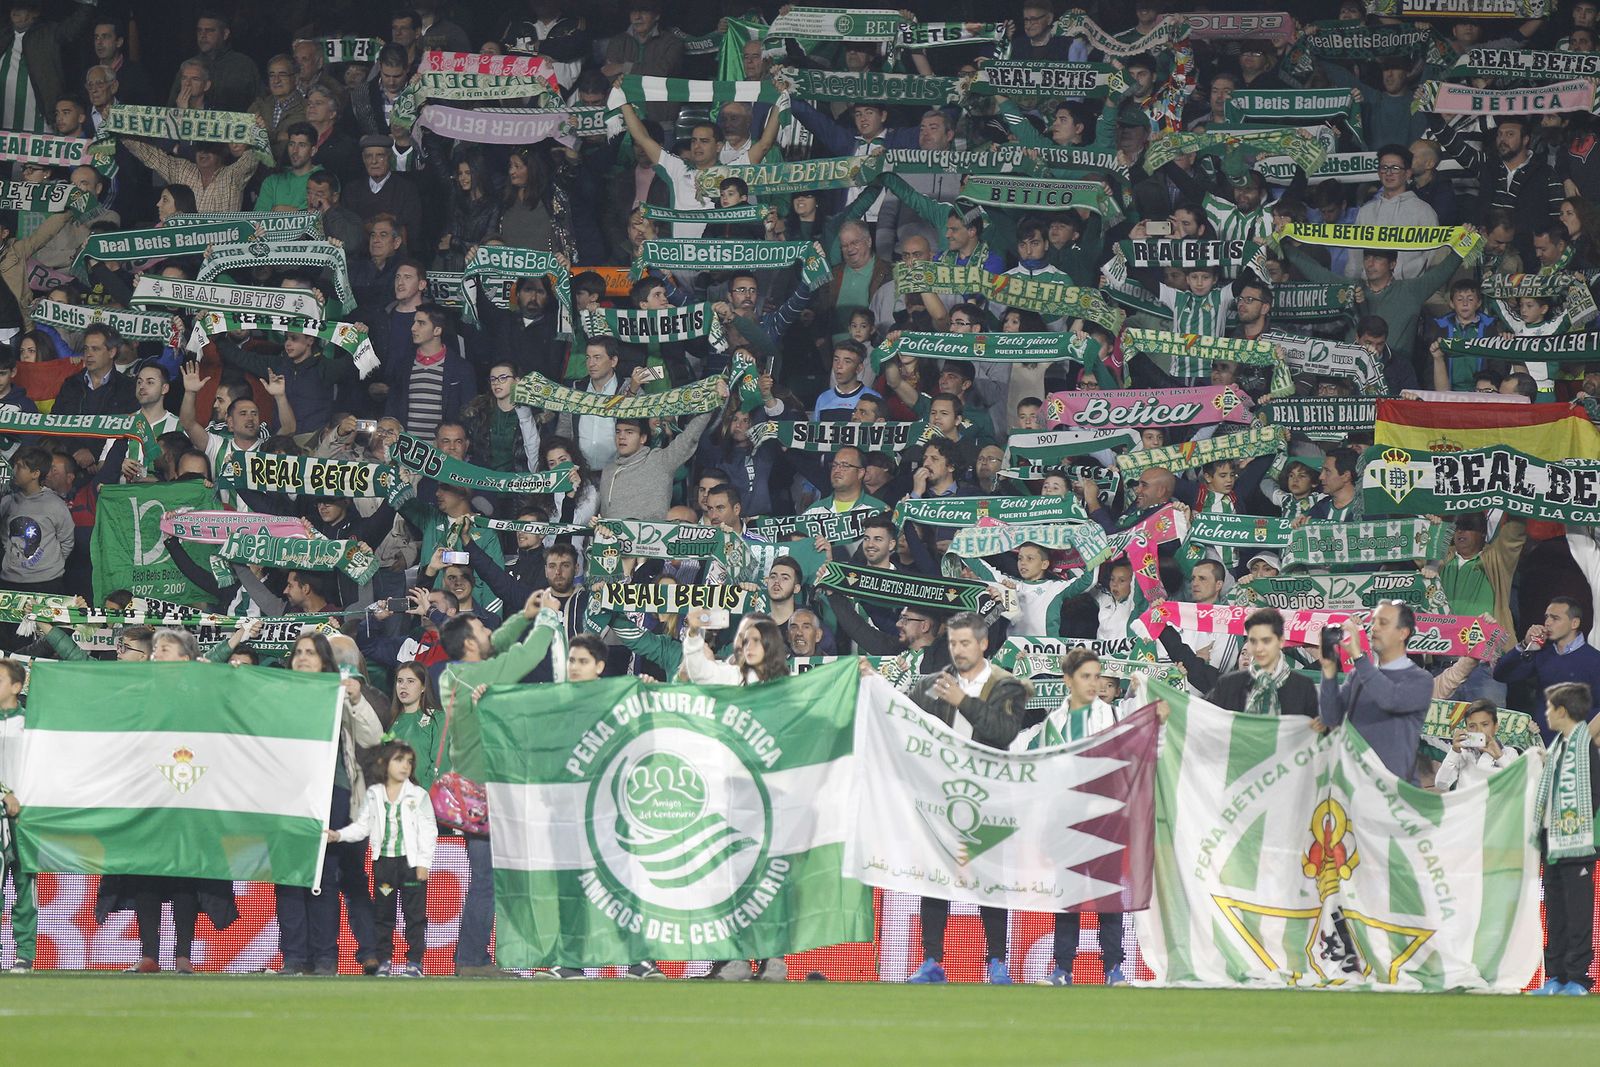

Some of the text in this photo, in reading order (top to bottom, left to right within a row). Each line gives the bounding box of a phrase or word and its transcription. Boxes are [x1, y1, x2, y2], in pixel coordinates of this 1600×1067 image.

[1188, 16, 1284, 33] BÉTIC
[1467, 49, 1598, 74] REAL BETIS
[988, 68, 1098, 89] REAL BETIS
[1254, 96, 1290, 110] Betis
[1471, 95, 1562, 111] BETICA
[30, 138, 83, 160] BETIS
[790, 160, 849, 183] BETIS
[991, 188, 1073, 205] BETICO
[1293, 224, 1455, 244] REAL BETIS BALOMPIÉ
[99, 240, 130, 254] Real
[134, 236, 171, 250] Betis
[937, 265, 994, 288] REAL
[1008, 278, 1081, 304] BETIS
[230, 290, 286, 309] BETIS
[1279, 287, 1329, 308] BALOMPIÉ
[52, 304, 85, 326] Betis
[109, 315, 136, 334] Real
[898, 336, 969, 353] Polichera
[1543, 331, 1586, 352] BETIS
[1073, 396, 1203, 427] Betica
[1273, 405, 1334, 423] REAL BETIS
[46, 414, 135, 430] REAL BETIS
[1037, 434, 1058, 444] 1907
[250, 458, 370, 491] REAL BETIS
[450, 473, 472, 484] Real
[1432, 451, 1535, 499] REAL
[904, 502, 973, 521] Polichera
[1029, 508, 1063, 517] SERRANO
[1445, 496, 1565, 519] LOCOS DE LA
[677, 526, 717, 541] tuyos
[1308, 536, 1343, 552] Betis
[132, 582, 186, 595] 1907 2007
[858, 574, 945, 601] REAL BETIS BALOMPIÉ
[1373, 574, 1415, 590] tuyos
[605, 582, 743, 609] REAL BETIS
[1263, 593, 1289, 609] 100
[1289, 592, 1324, 609] años
[566, 691, 783, 776] PEÑA CULTURAL BÉTICA
[905, 735, 1038, 783] DE QATAR
[653, 798, 682, 809] Amigos
[640, 810, 652, 820] del
[1195, 826, 1227, 882] PEÑA
[1221, 761, 1291, 825] BÉTICA
[1416, 837, 1456, 922] GARCÍA
[578, 858, 791, 944] AMIGOS DEL CENTENARIO
